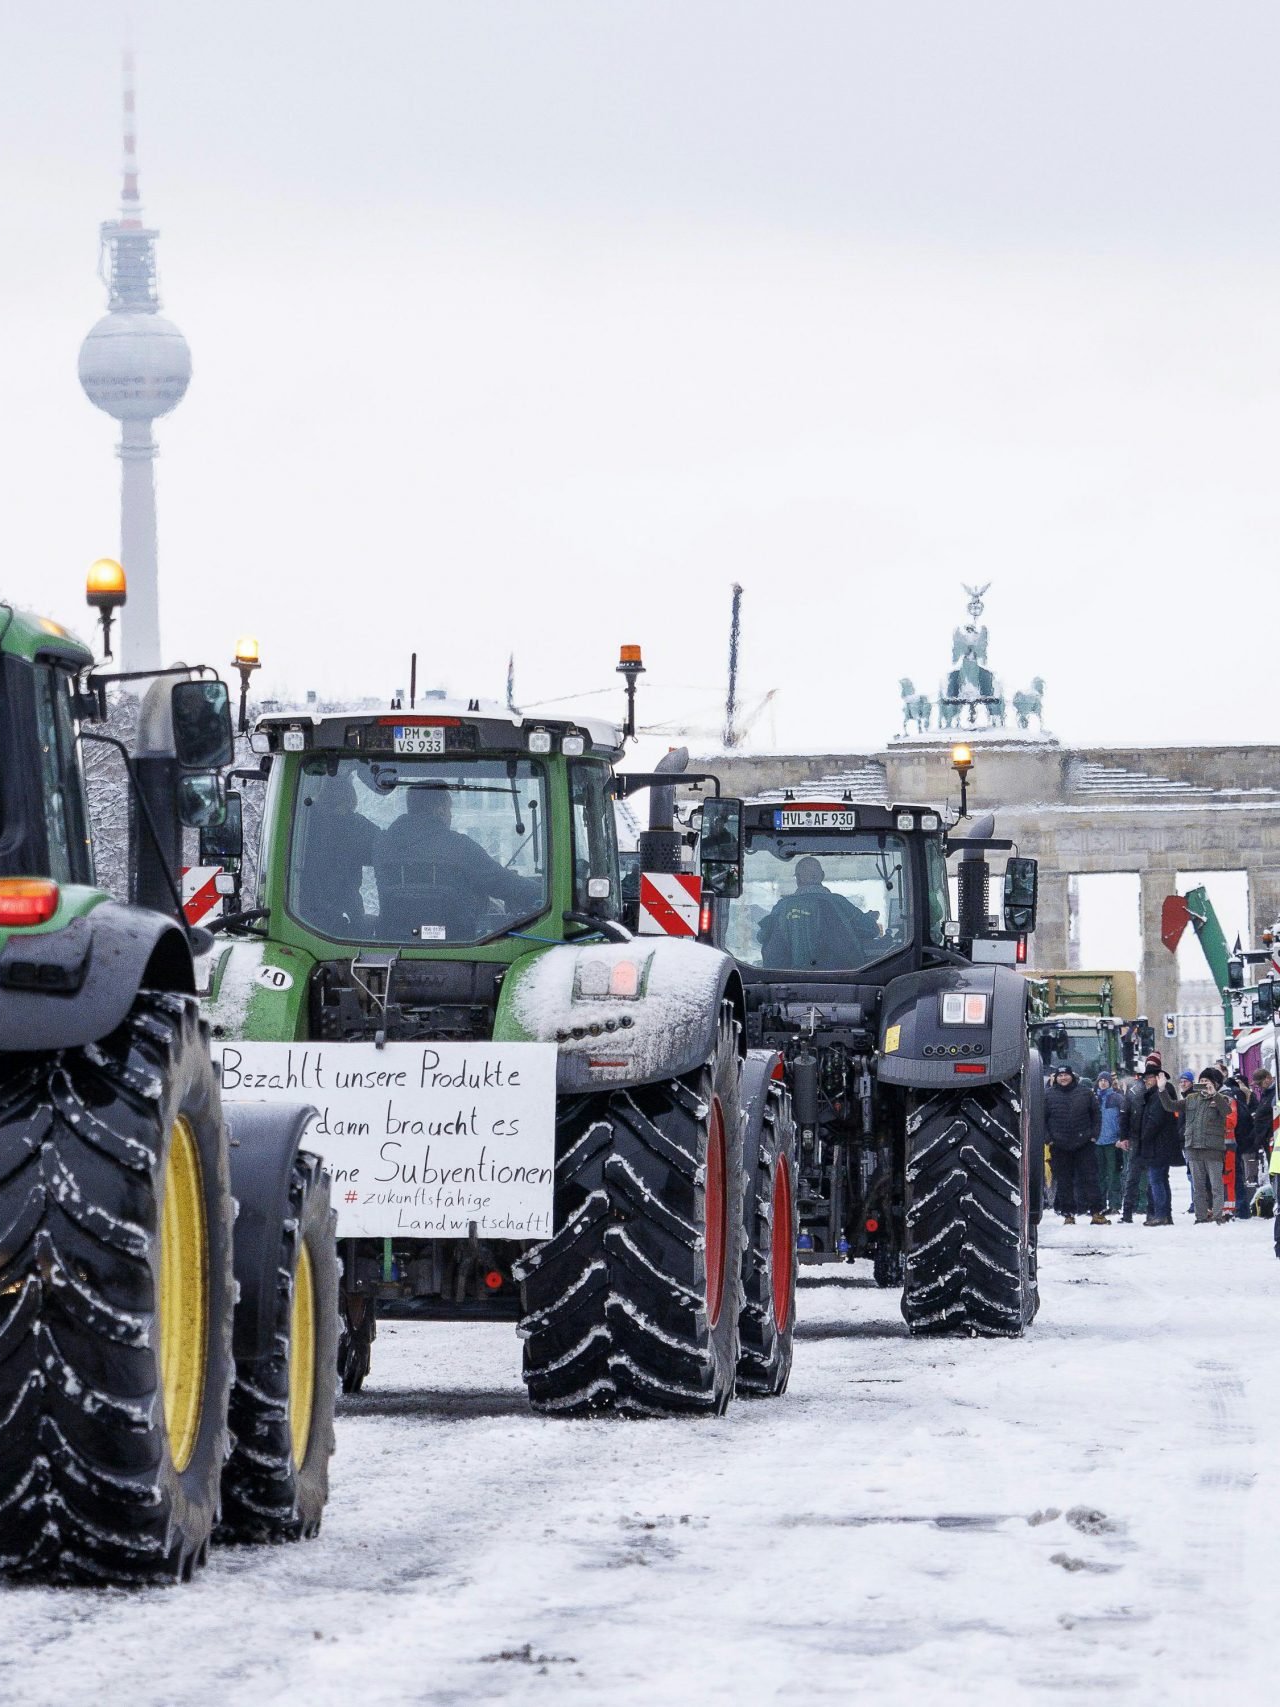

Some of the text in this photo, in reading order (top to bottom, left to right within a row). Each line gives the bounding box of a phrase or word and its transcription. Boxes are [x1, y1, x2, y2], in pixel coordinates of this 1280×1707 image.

[398, 740, 441, 753] VS 933
[404, 727, 420, 740] PM
[782, 812, 853, 826] HVL AF 930
[221, 1048, 521, 1090] Bezahlt unsere Produkte
[315, 1099, 520, 1137] dann braucht es
[374, 1141, 553, 1185] Subventionen
